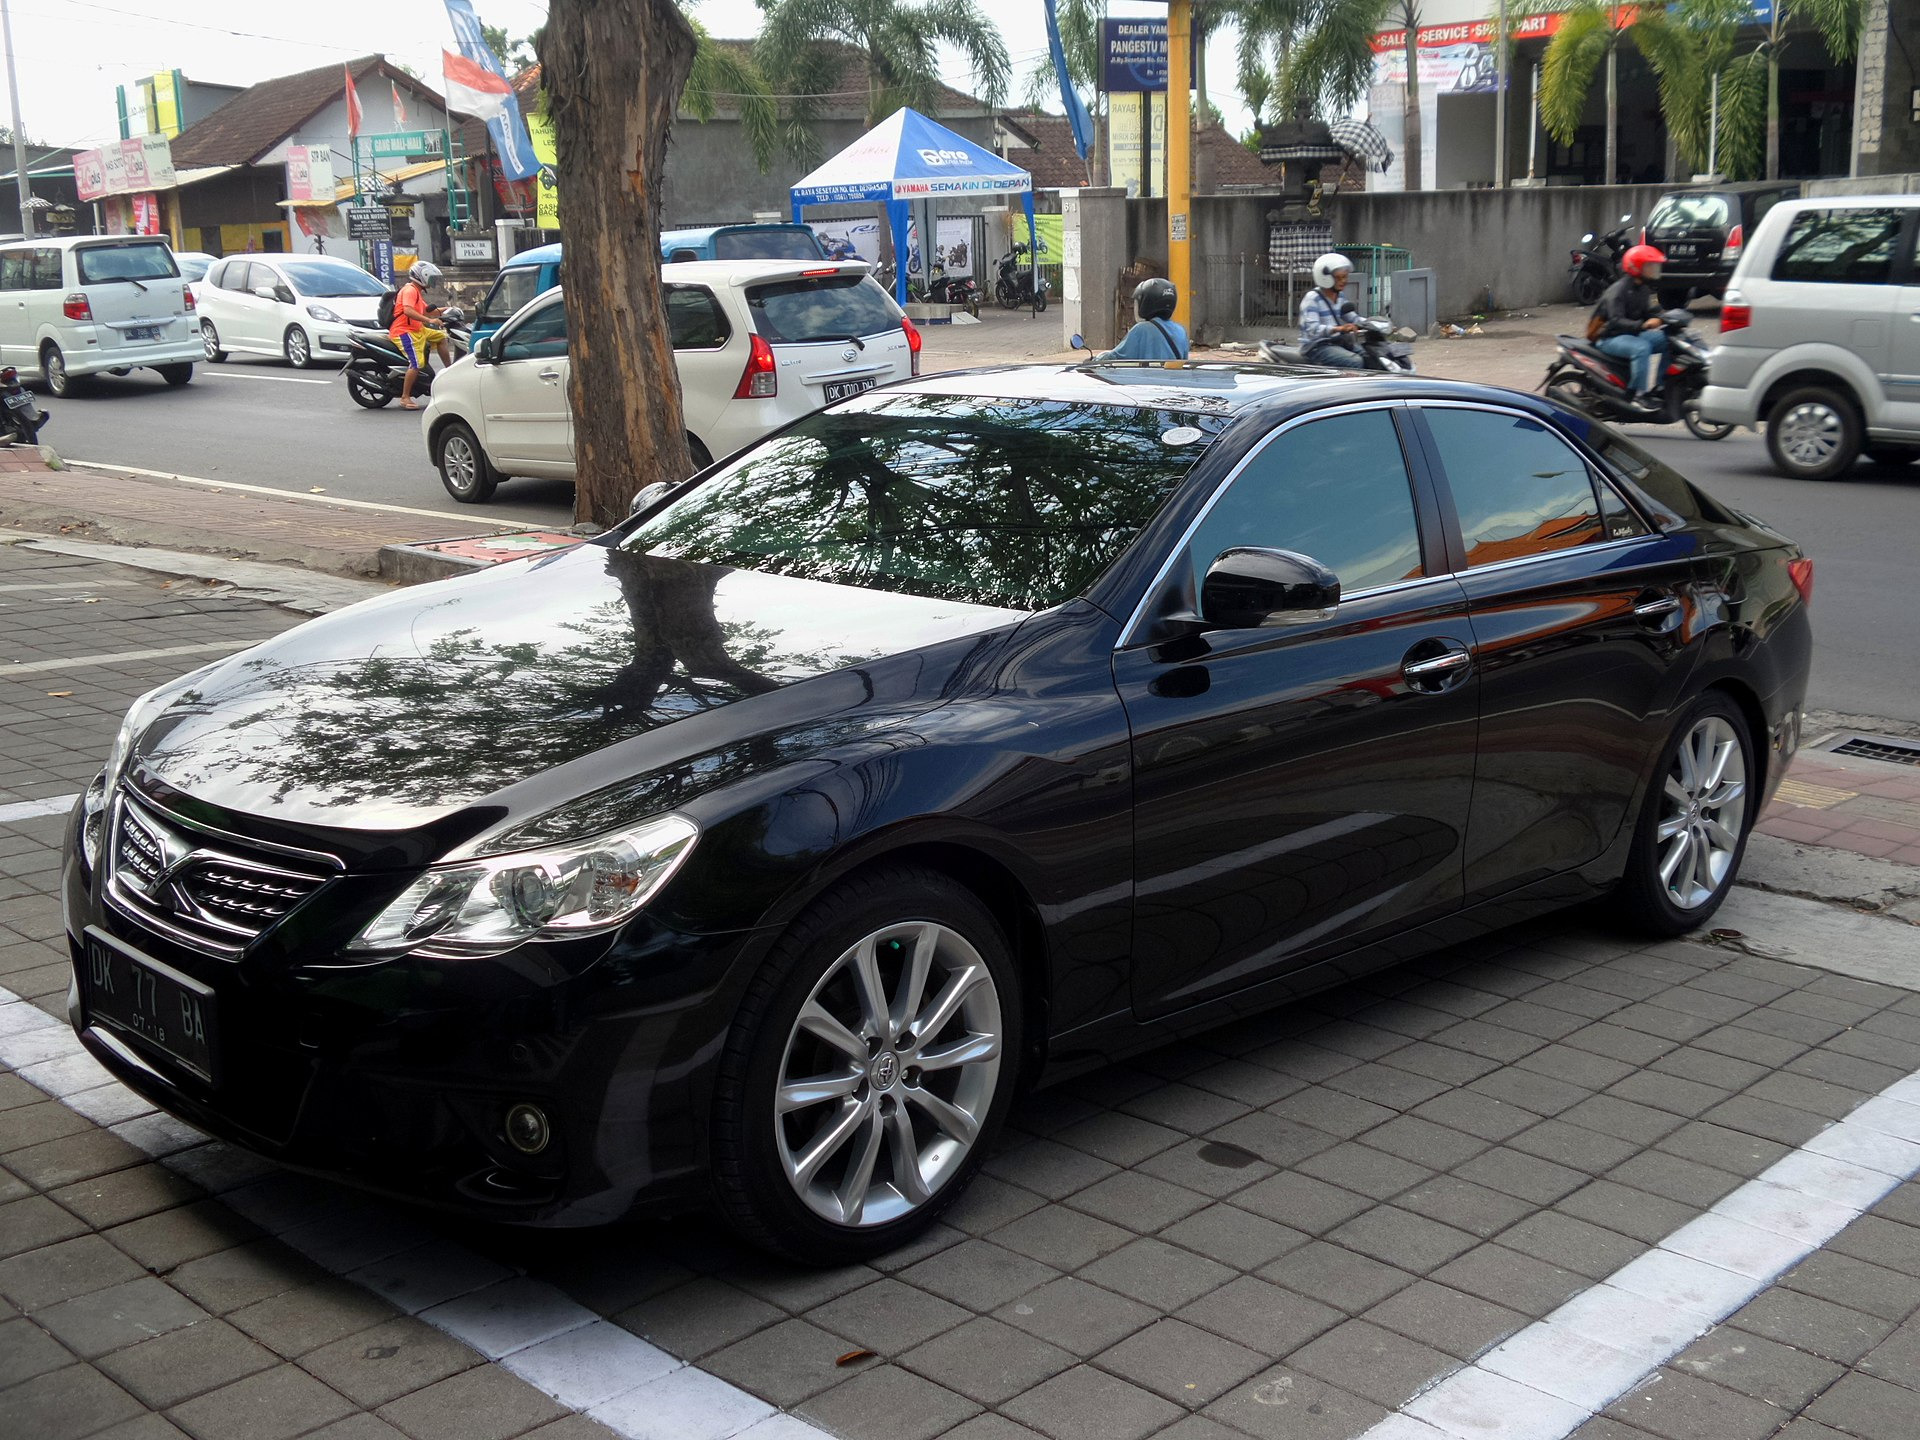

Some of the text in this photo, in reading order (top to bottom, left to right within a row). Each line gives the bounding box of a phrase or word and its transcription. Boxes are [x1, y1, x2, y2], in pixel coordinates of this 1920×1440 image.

[1118, 24, 1149, 35] DEALER
[1421, 25, 1469, 42] SERVICE
[1110, 39, 1158, 53] PANGESTU
[815, 185, 840, 195] SESETAN
[902, 183, 930, 193] YAMAHA
[993, 178, 1030, 189] DEPAN
[828, 386, 842, 400] DK
[91, 942, 206, 1046] DK 77 BA
